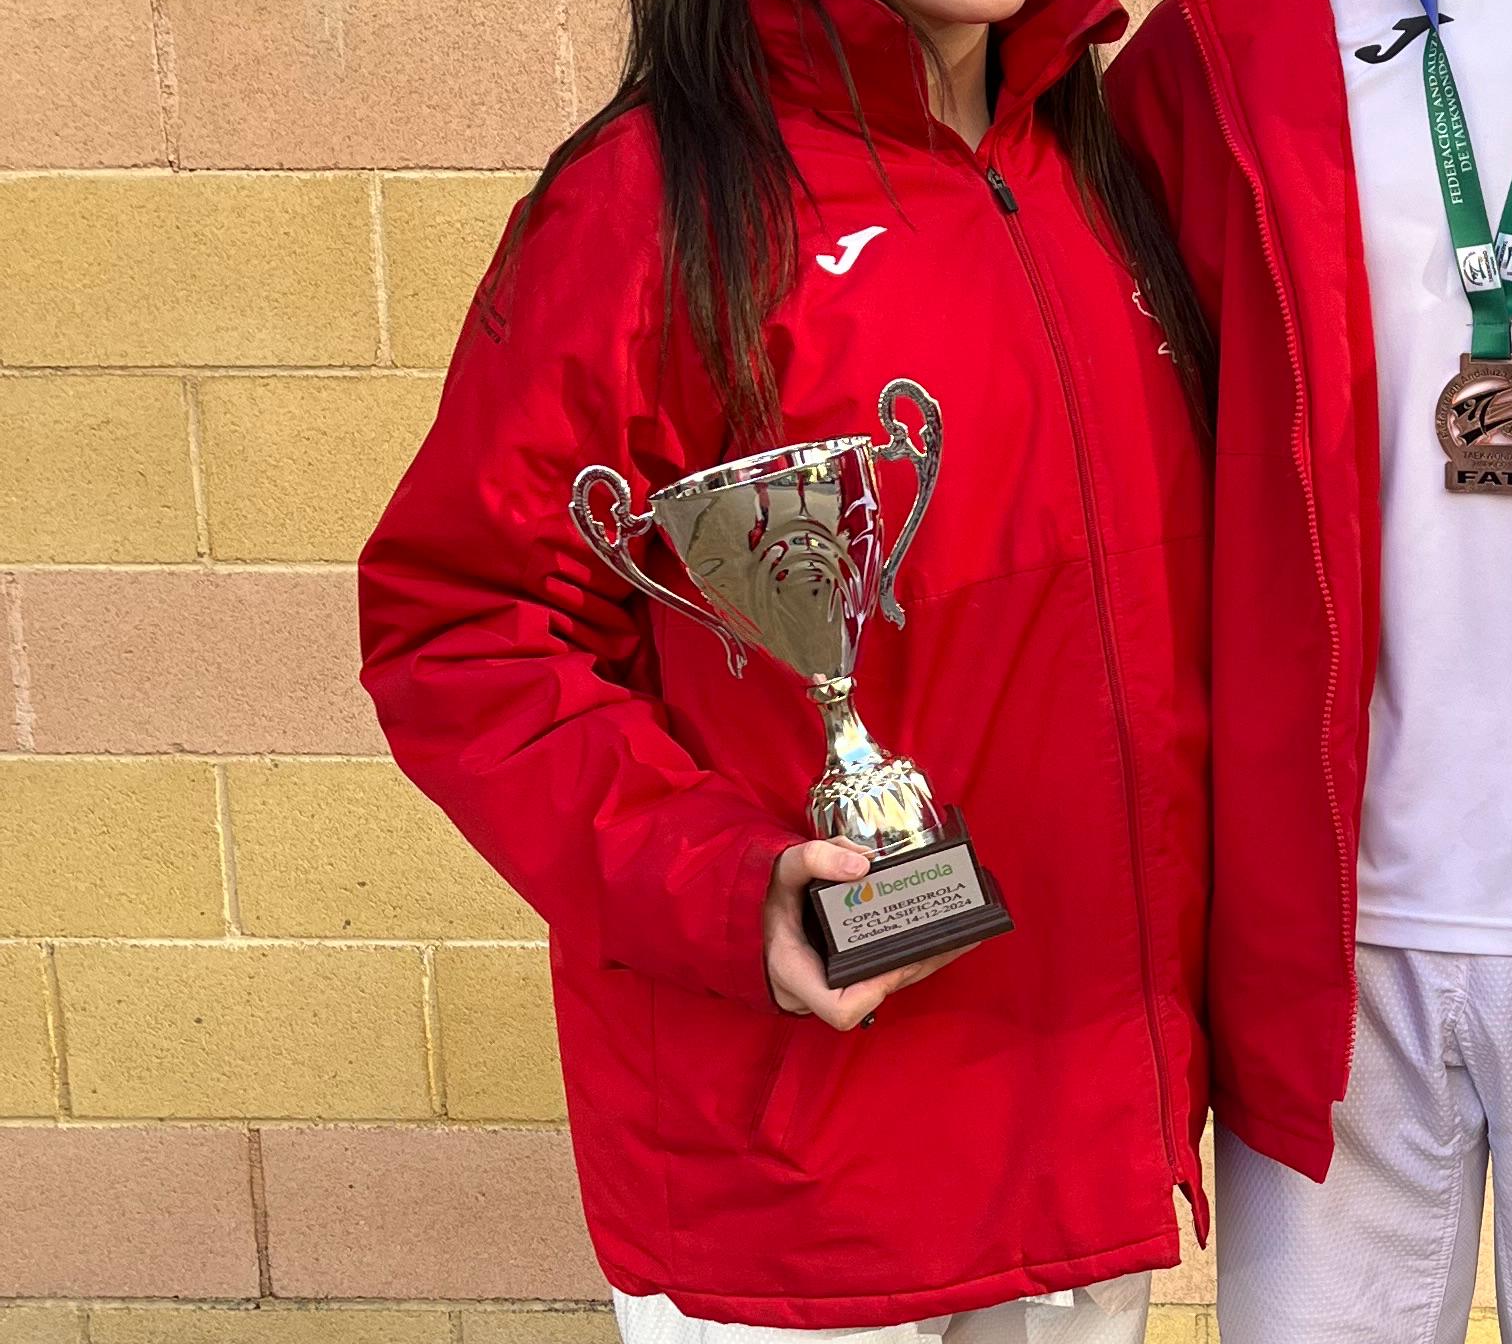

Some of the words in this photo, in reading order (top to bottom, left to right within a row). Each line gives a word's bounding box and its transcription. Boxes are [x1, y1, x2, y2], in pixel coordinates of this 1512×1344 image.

[1428, 31, 1444, 107] ANDALUZA
[1438, 52, 1467, 151] TAEKWONDO
[1435, 111, 1464, 205] FEDERACIÓN
[1457, 152, 1473, 173] DE
[876, 863, 953, 897] Iberdrola
[842, 910, 880, 927] COPA
[883, 882, 966, 914] IBERDROLA
[866, 893, 962, 928] CLASIFICADA
[906, 898, 972, 925] 14-12-2024
